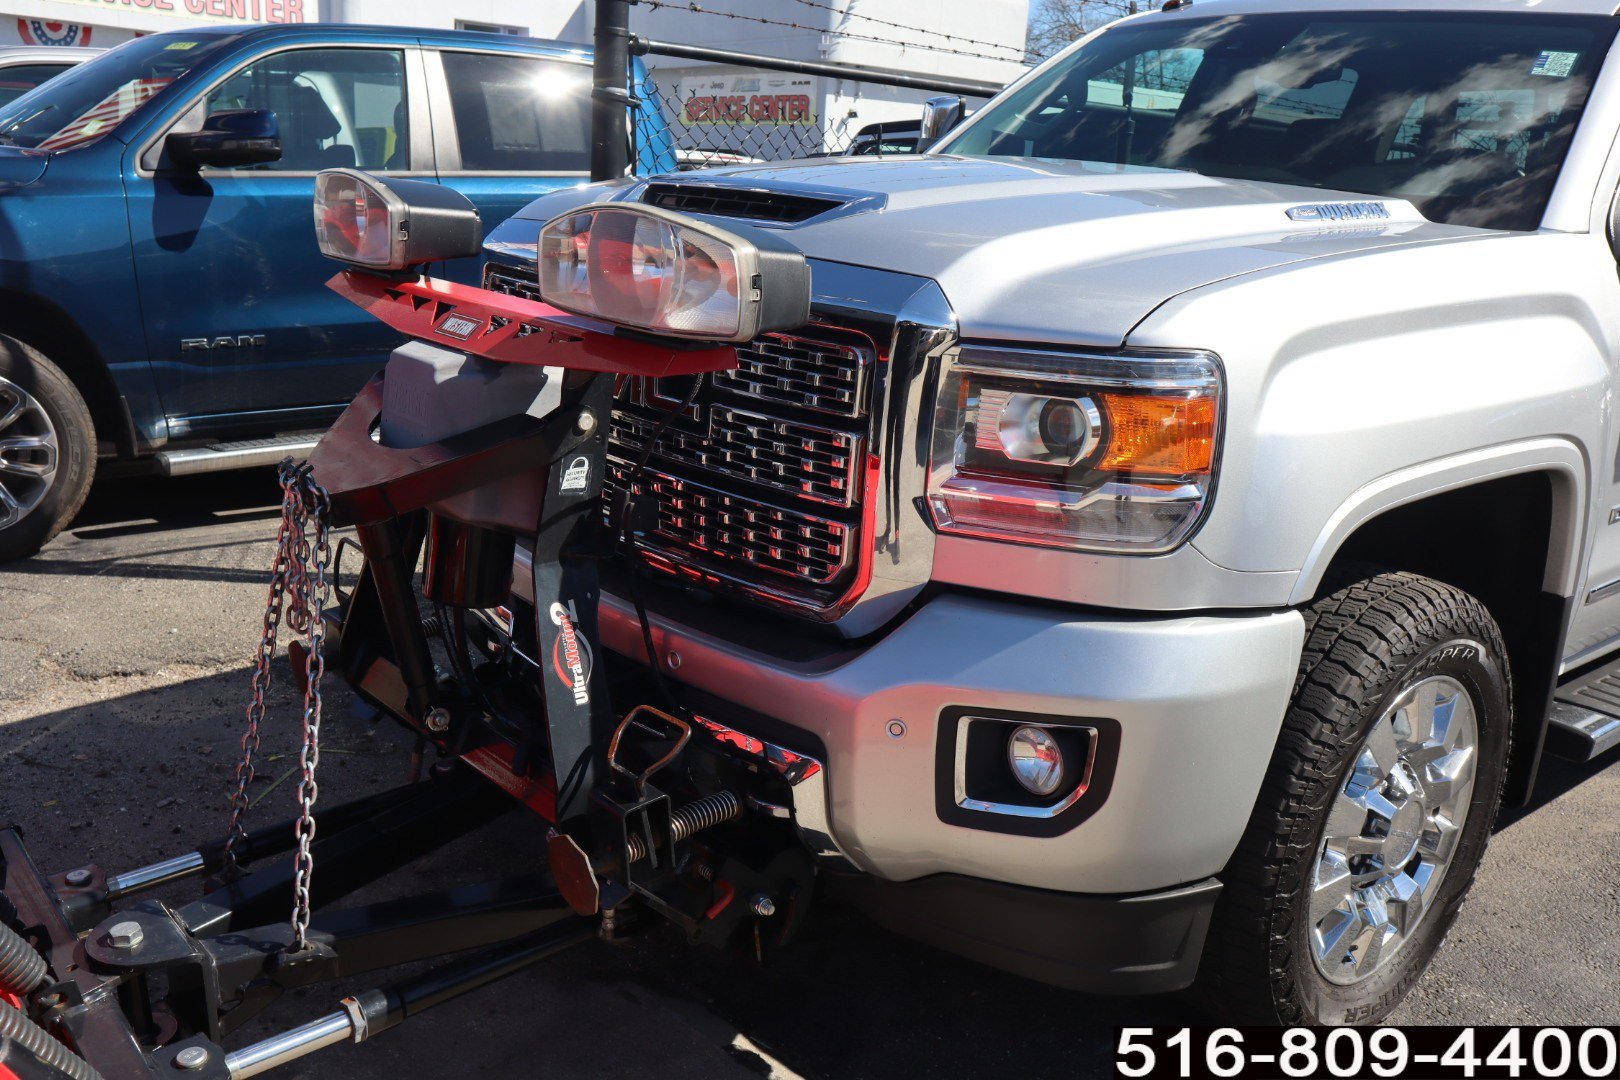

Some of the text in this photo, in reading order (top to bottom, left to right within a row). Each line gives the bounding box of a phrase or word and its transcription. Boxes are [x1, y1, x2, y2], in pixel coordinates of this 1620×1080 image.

[686, 94, 810, 122] SERVICE CENTER
[441, 316, 477, 335] WESTERN
[181, 334, 266, 351] RAM
